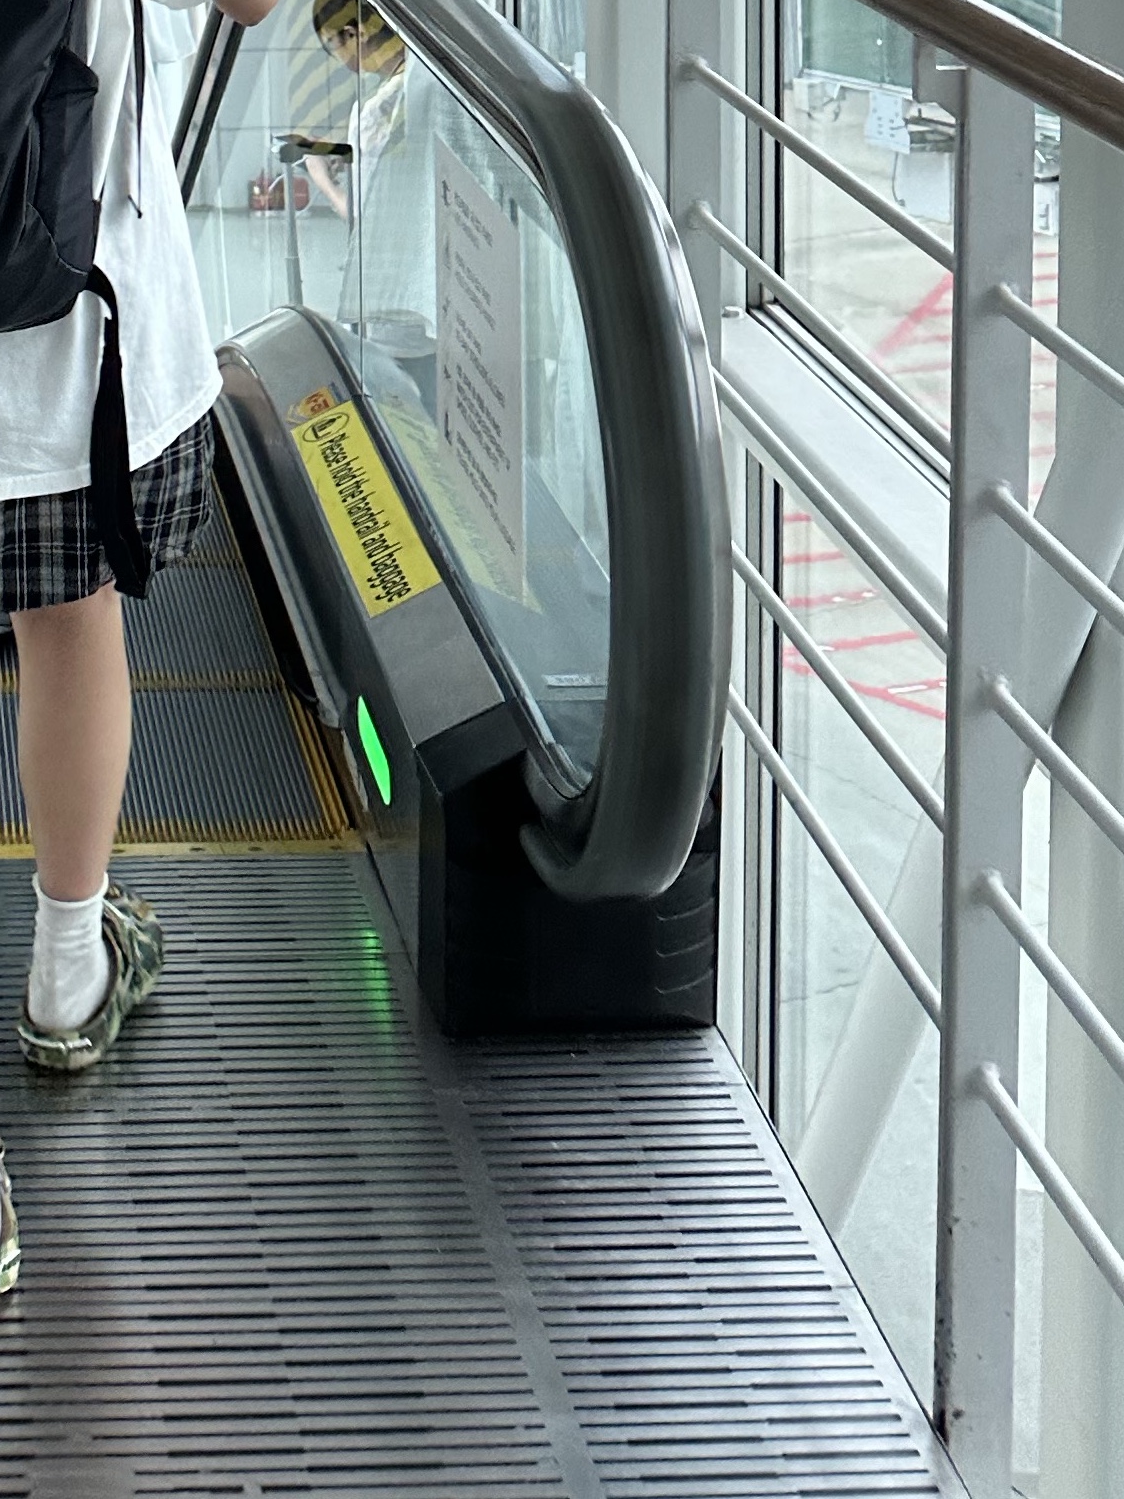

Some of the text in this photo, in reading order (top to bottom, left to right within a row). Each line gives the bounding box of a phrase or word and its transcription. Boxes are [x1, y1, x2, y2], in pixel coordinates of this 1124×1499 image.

[319, 432, 350, 468] Please
[329, 455, 366, 488] hold
[336, 475, 373, 504] the
[344, 490, 391, 540] handrail
[361, 528, 400, 559] and
[365, 546, 415, 605] baggage
